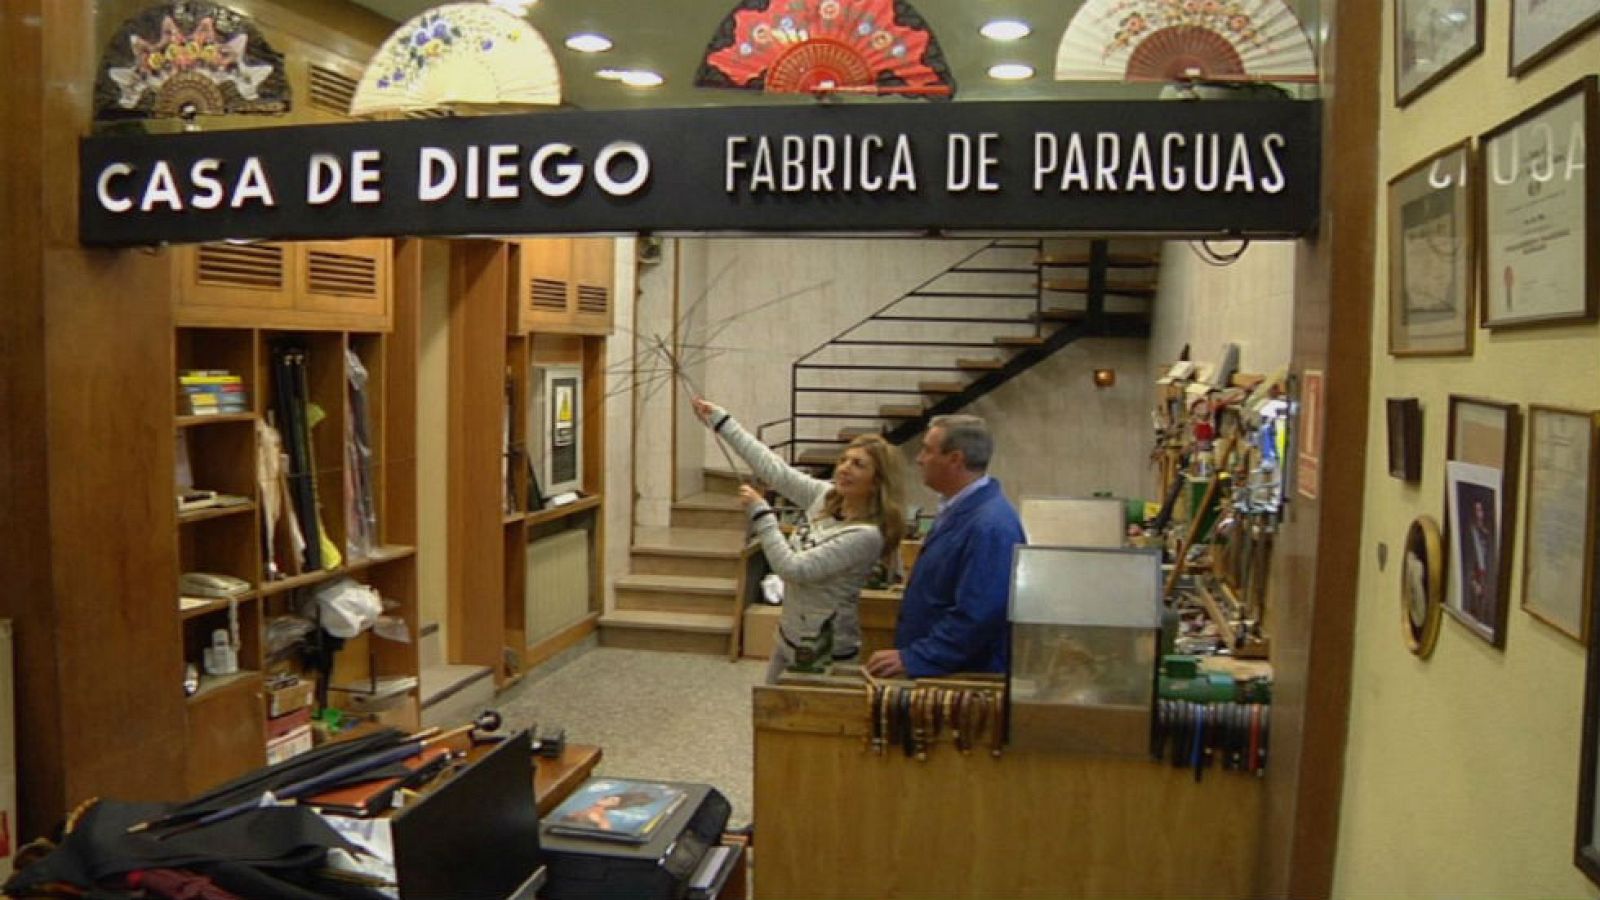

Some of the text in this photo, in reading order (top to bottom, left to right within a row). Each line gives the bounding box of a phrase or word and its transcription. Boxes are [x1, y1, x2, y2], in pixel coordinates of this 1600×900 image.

[97, 141, 649, 212] CASA DE DIEGO
[725, 131, 1286, 194] FABRICA DE PARAGUAS
